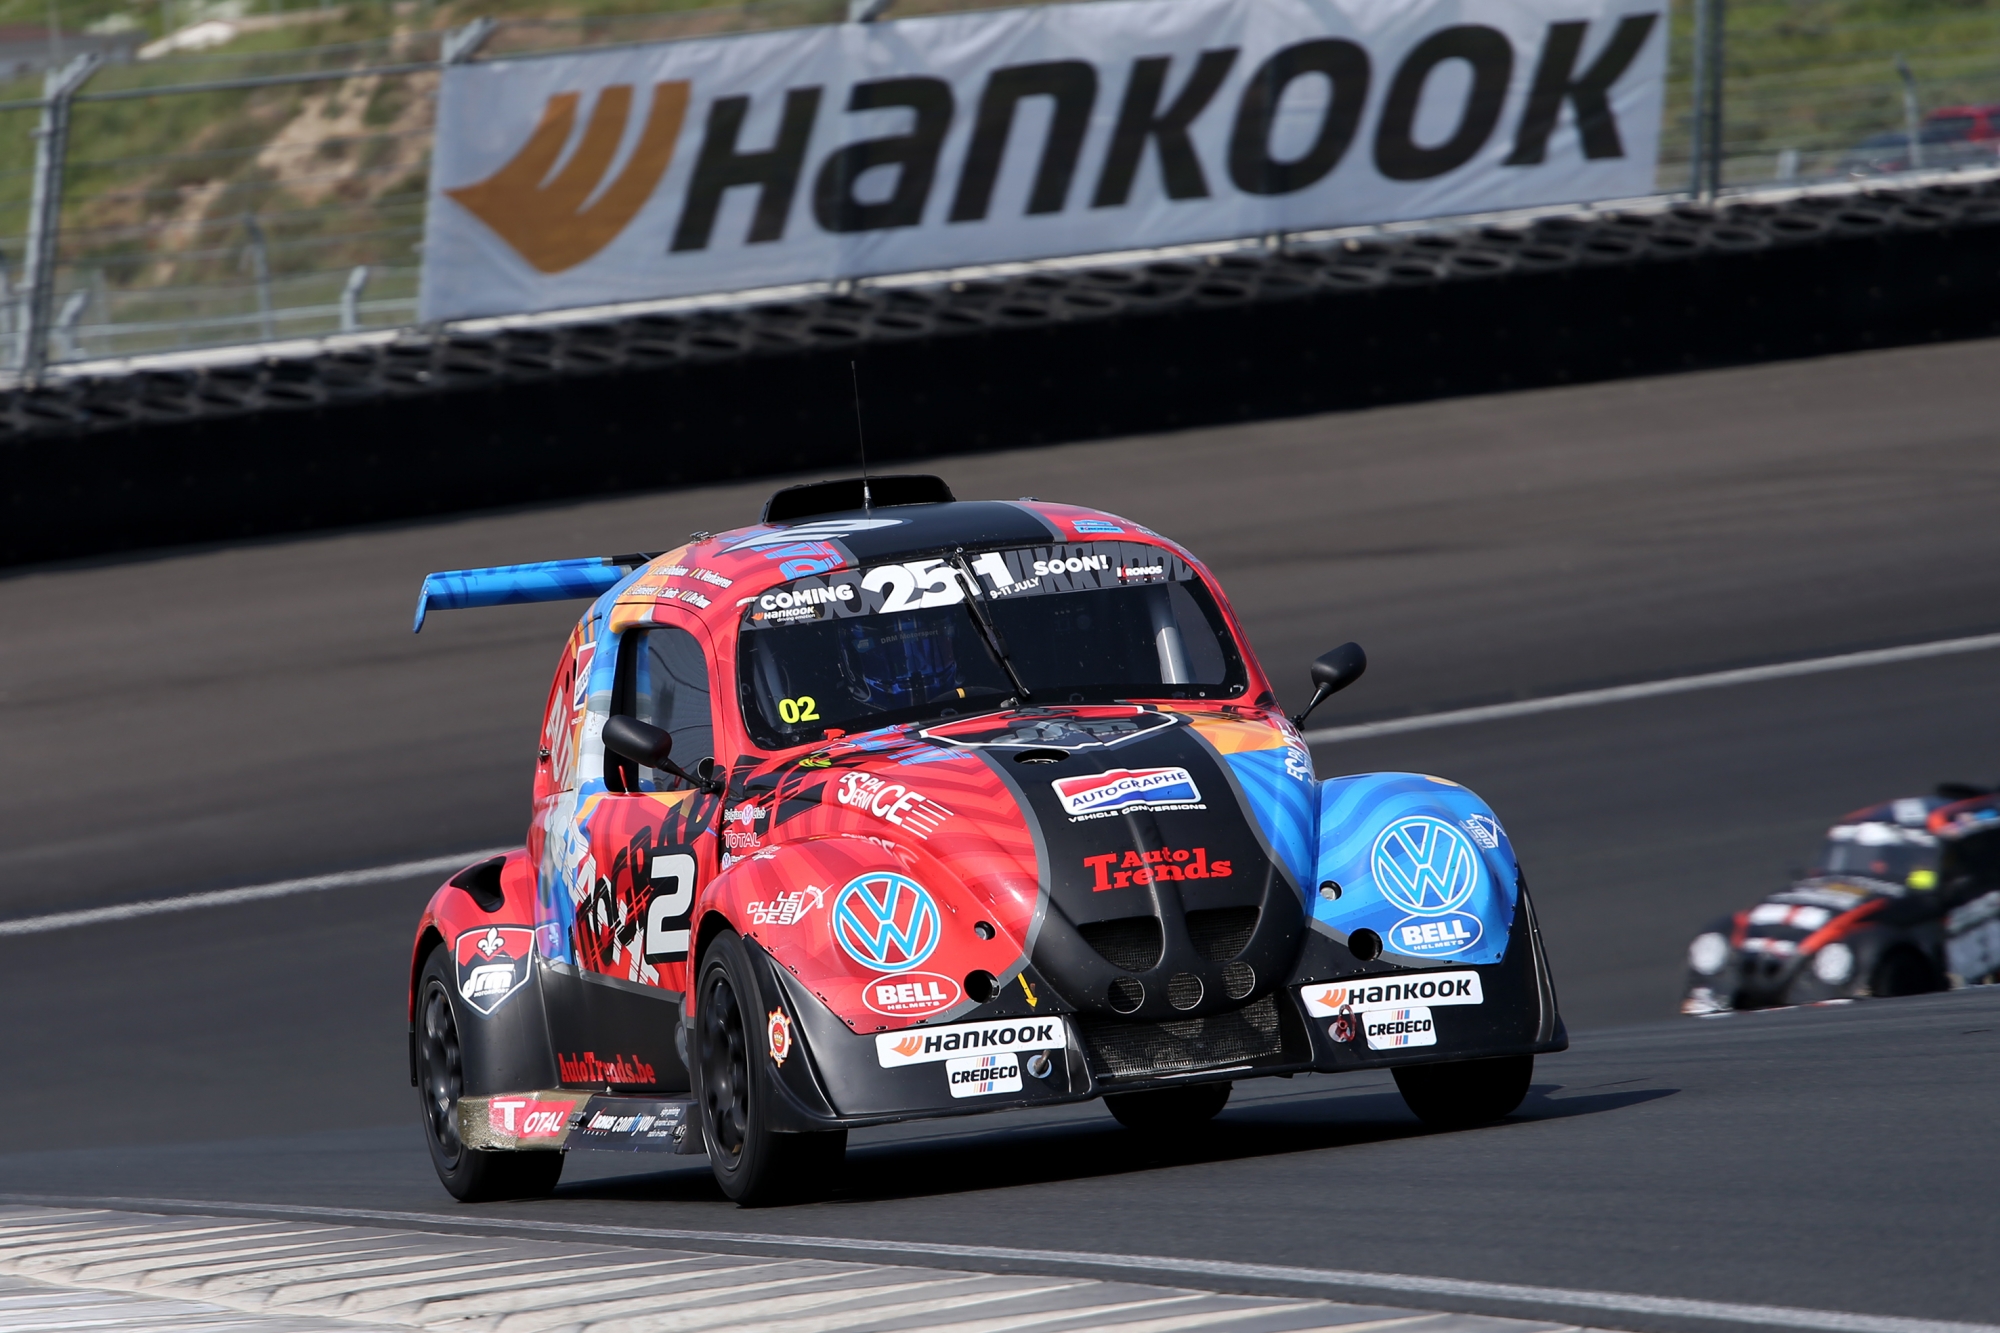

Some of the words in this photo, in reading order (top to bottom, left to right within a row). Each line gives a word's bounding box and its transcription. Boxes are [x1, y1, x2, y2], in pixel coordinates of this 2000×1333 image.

[760, 585, 854, 610] COMING
[1033, 554, 1109, 577] SOON!
[990, 585, 1012, 600] 9-11
[1014, 576, 1040, 592] JULY
[778, 696, 820, 724] 02
[1072, 771, 1188, 807] AUTOGRAPHE
[1068, 810, 1119, 823] VEHICLE
[1121, 803, 1207, 815] CONVERSIONS
[1121, 847, 1190, 868] Auto
[1083, 848, 1233, 892] Trends
[647, 853, 695, 955] 2
[746, 900, 798, 914] CLUB
[752, 912, 793, 925] DES
[1401, 919, 1471, 945] BELL
[1413, 939, 1464, 950] HELMETS
[875, 982, 947, 1005] BELL
[887, 1001, 940, 1011] HELMETS
[1368, 1019, 1431, 1036] CREDECO
[951, 1065, 1018, 1084] CREDECO
